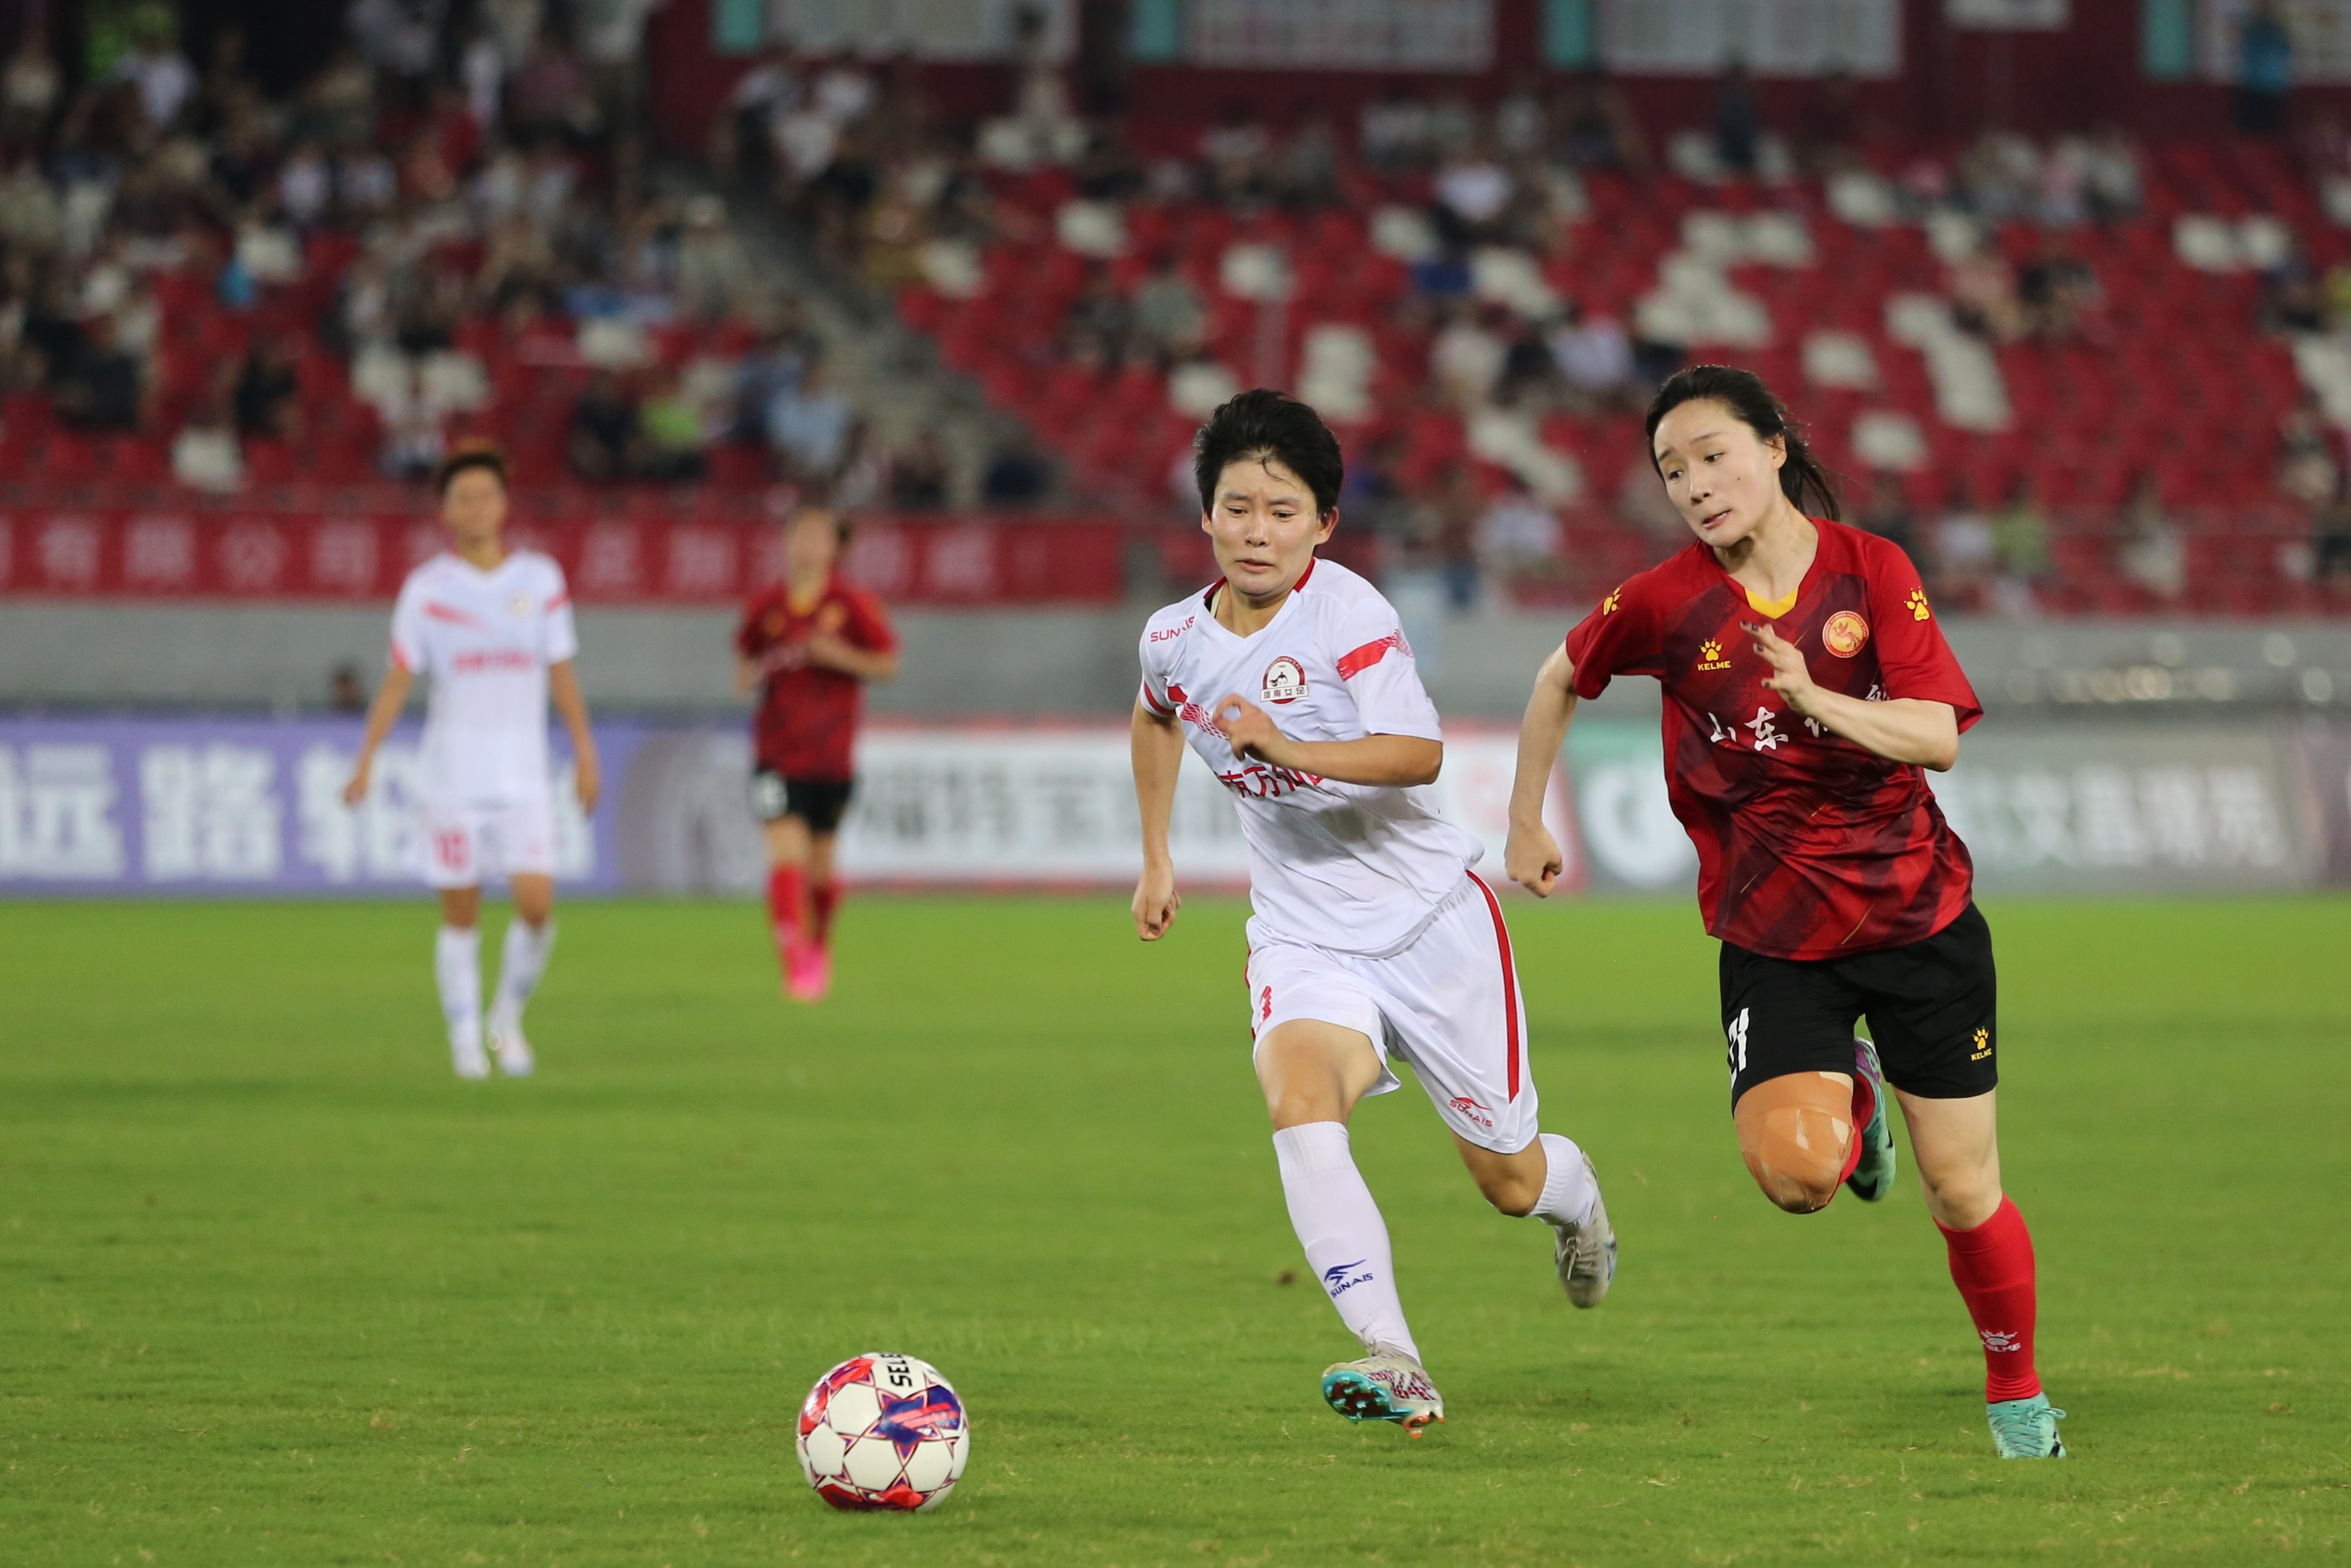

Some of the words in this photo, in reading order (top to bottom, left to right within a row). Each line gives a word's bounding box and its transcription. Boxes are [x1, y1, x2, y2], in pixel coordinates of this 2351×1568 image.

[1150, 615, 1195, 643] SUNIS
[1697, 660, 1732, 671] KELME
[1970, 1047, 1992, 1061] KELME
[1449, 1099, 1493, 1127] SUNAIS
[1330, 1273, 1373, 1298] SUNAIS
